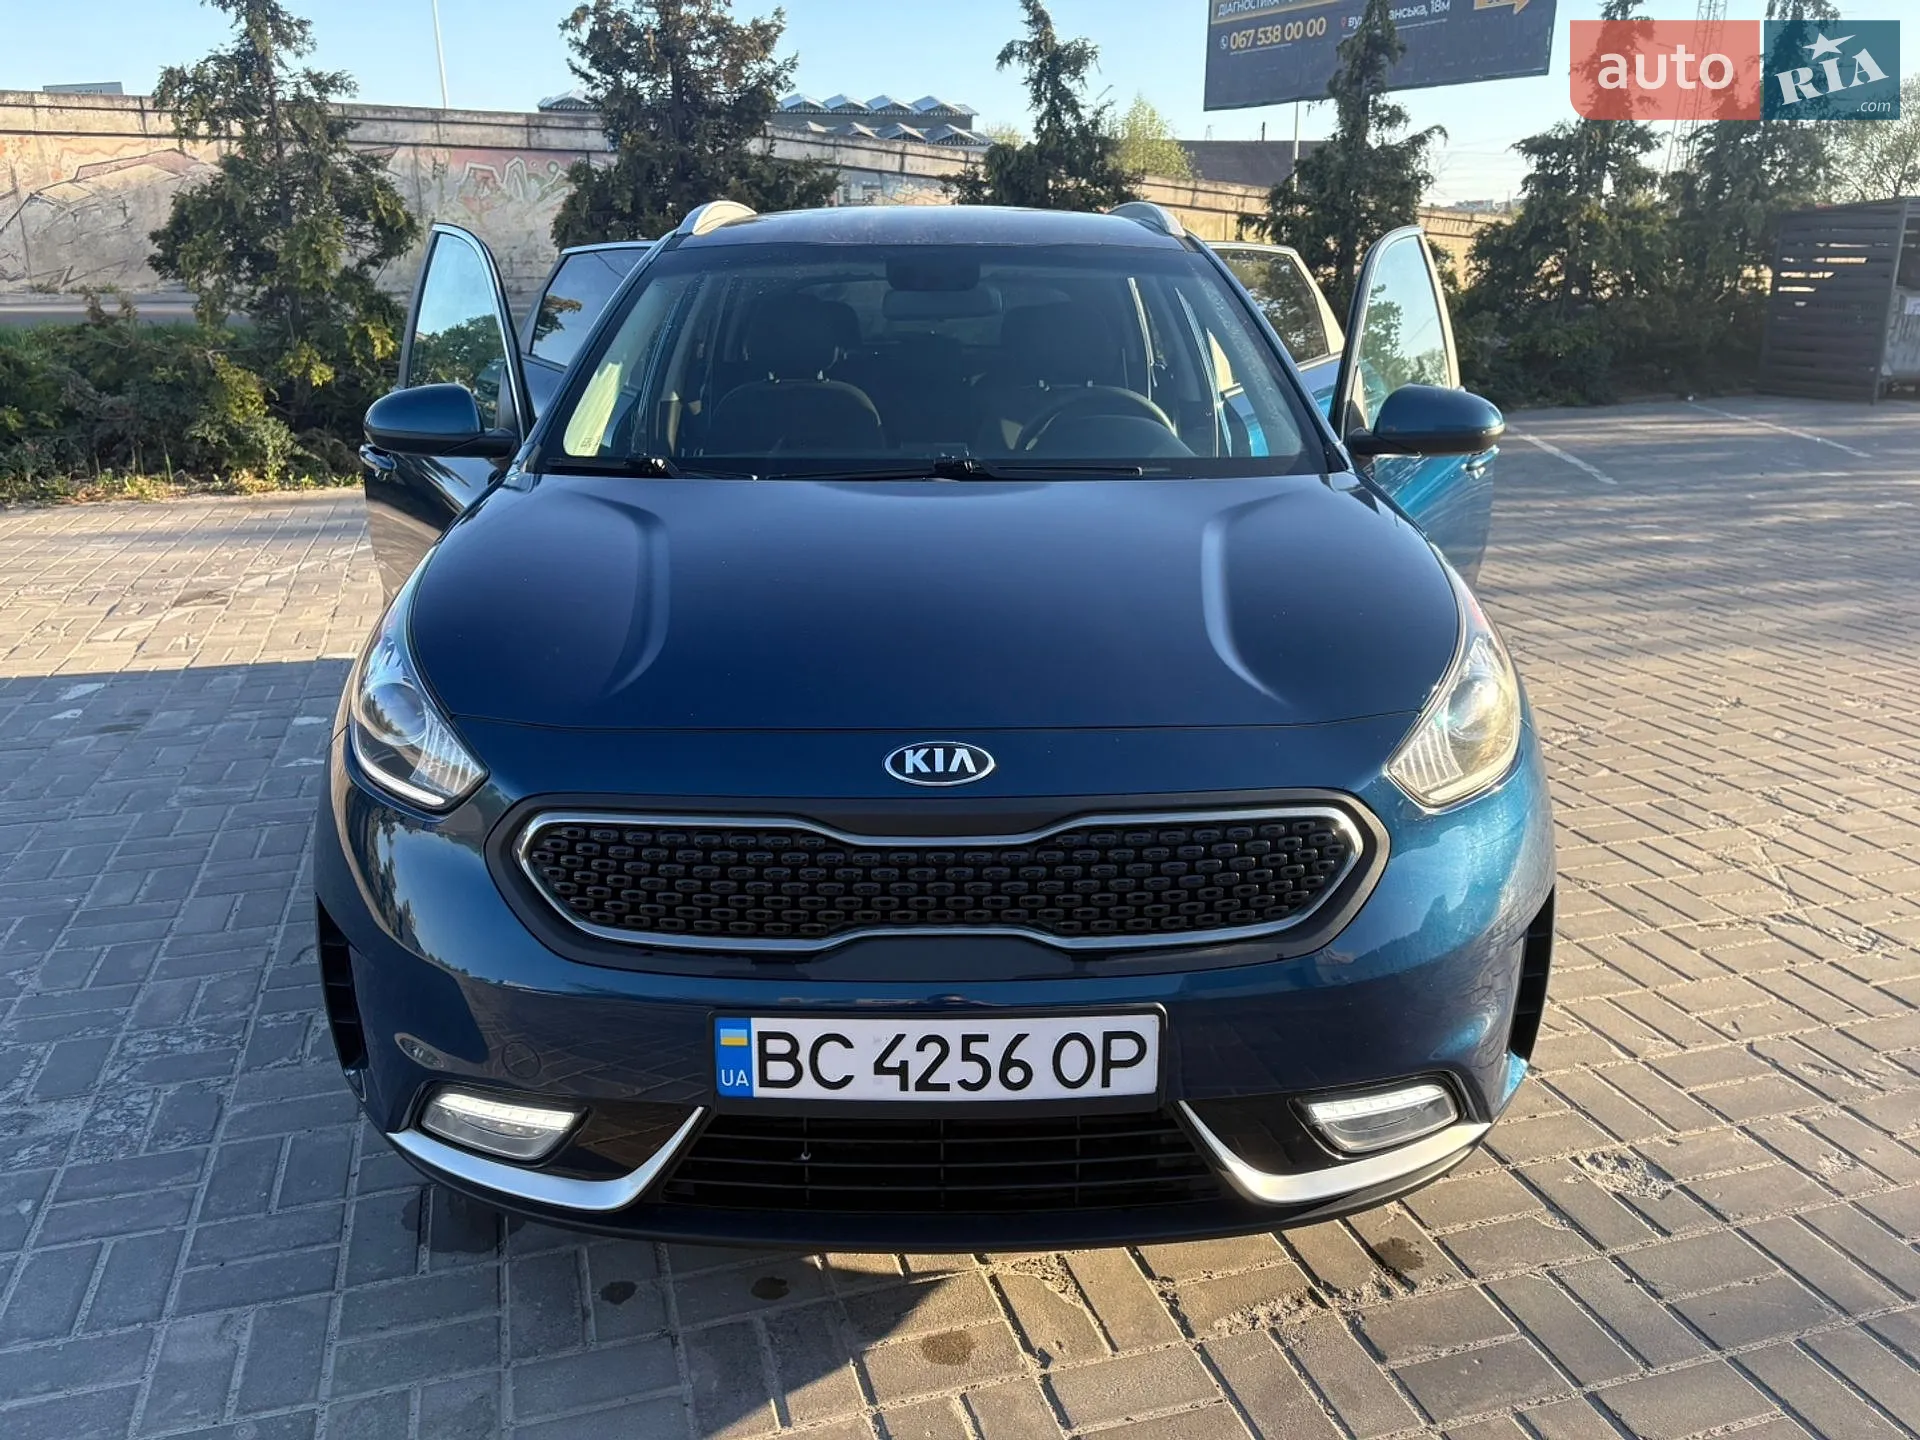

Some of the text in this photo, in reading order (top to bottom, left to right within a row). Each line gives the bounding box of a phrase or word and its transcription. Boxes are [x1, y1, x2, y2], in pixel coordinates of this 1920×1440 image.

[1229, 16, 1327, 50] 067 538 00 00
[904, 747, 977, 774] KIA
[757, 1030, 1147, 1092] BC 4256 OP
[721, 1069, 749, 1087] UA
